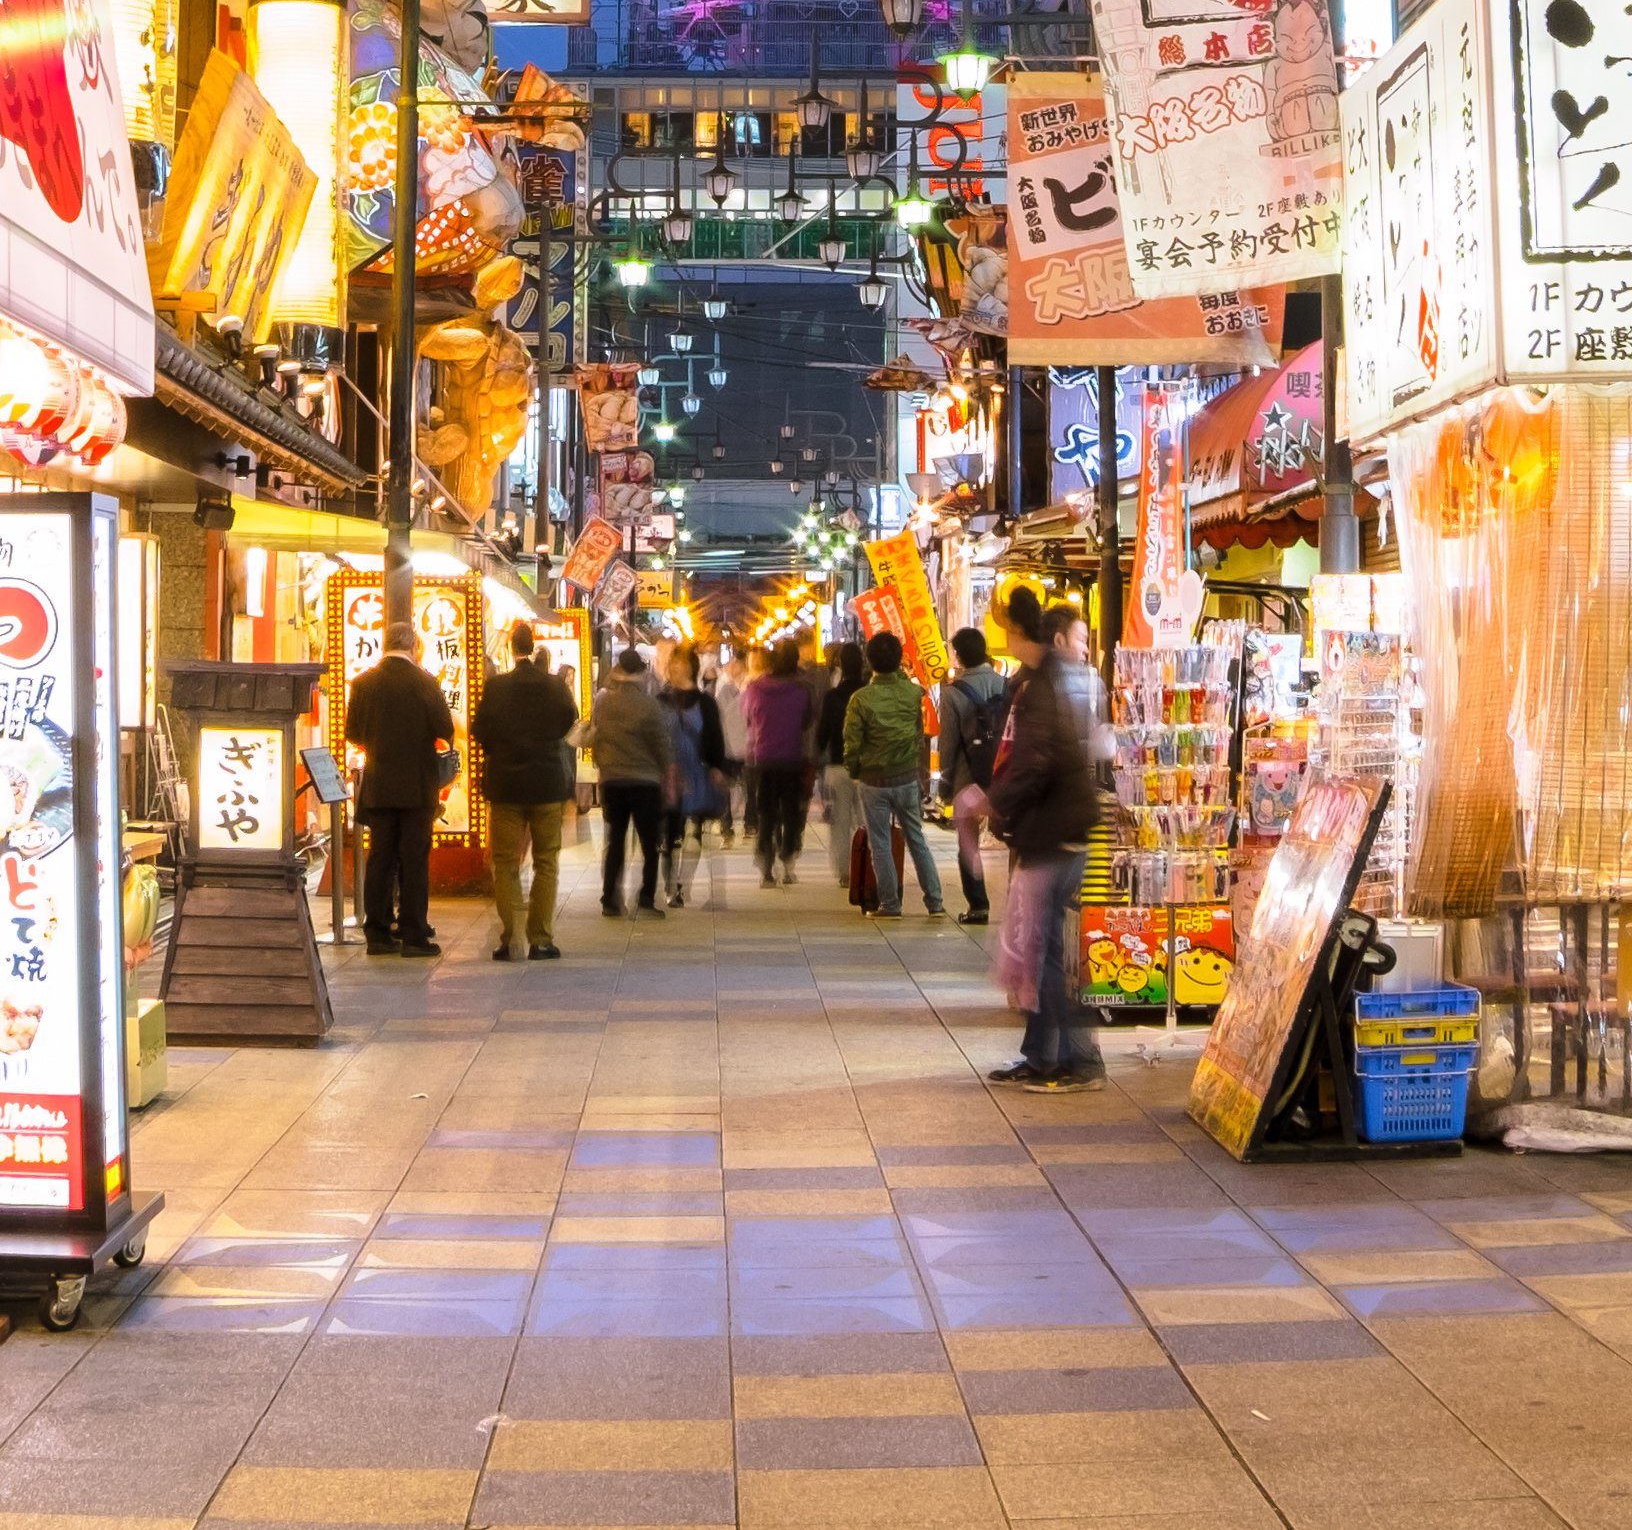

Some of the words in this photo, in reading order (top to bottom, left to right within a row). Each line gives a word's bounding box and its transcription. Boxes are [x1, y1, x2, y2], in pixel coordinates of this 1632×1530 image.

[1156, 21, 1278, 68] 総本店
[1020, 102, 1079, 132] 新世界
[1117, 74, 1270, 160] 大阪名物
[1014, 175, 1048, 246] 大阪名物
[1132, 207, 1242, 234] 1Fカウンター
[1136, 210, 1342, 272] 宴会予約受付中
[1528, 282, 1560, 312] 1F
[1205, 306, 1272, 336] おおきに
[1528, 328, 1561, 359] 2F
[218, 734, 261, 843] ぎふや
